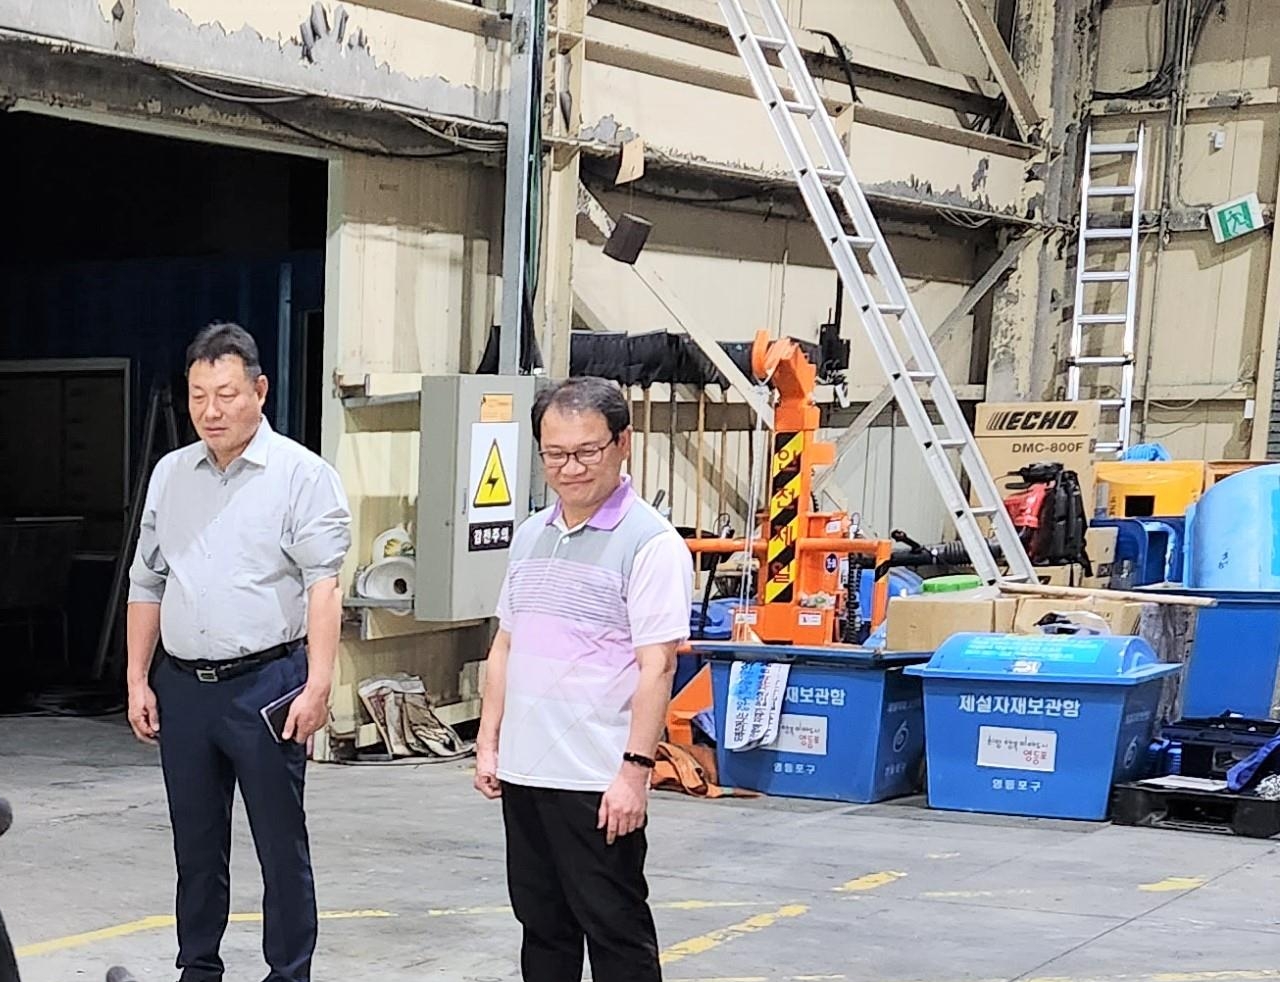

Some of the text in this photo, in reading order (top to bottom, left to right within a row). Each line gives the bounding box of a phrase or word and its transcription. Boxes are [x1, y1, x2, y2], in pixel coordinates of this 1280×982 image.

[1005, 410, 1078, 431] ECHO
[1011, 442, 1085, 453] DMC-800F
[785, 686, 846, 706] 재보관함
[958, 694, 1080, 717] 제설자재보관함
